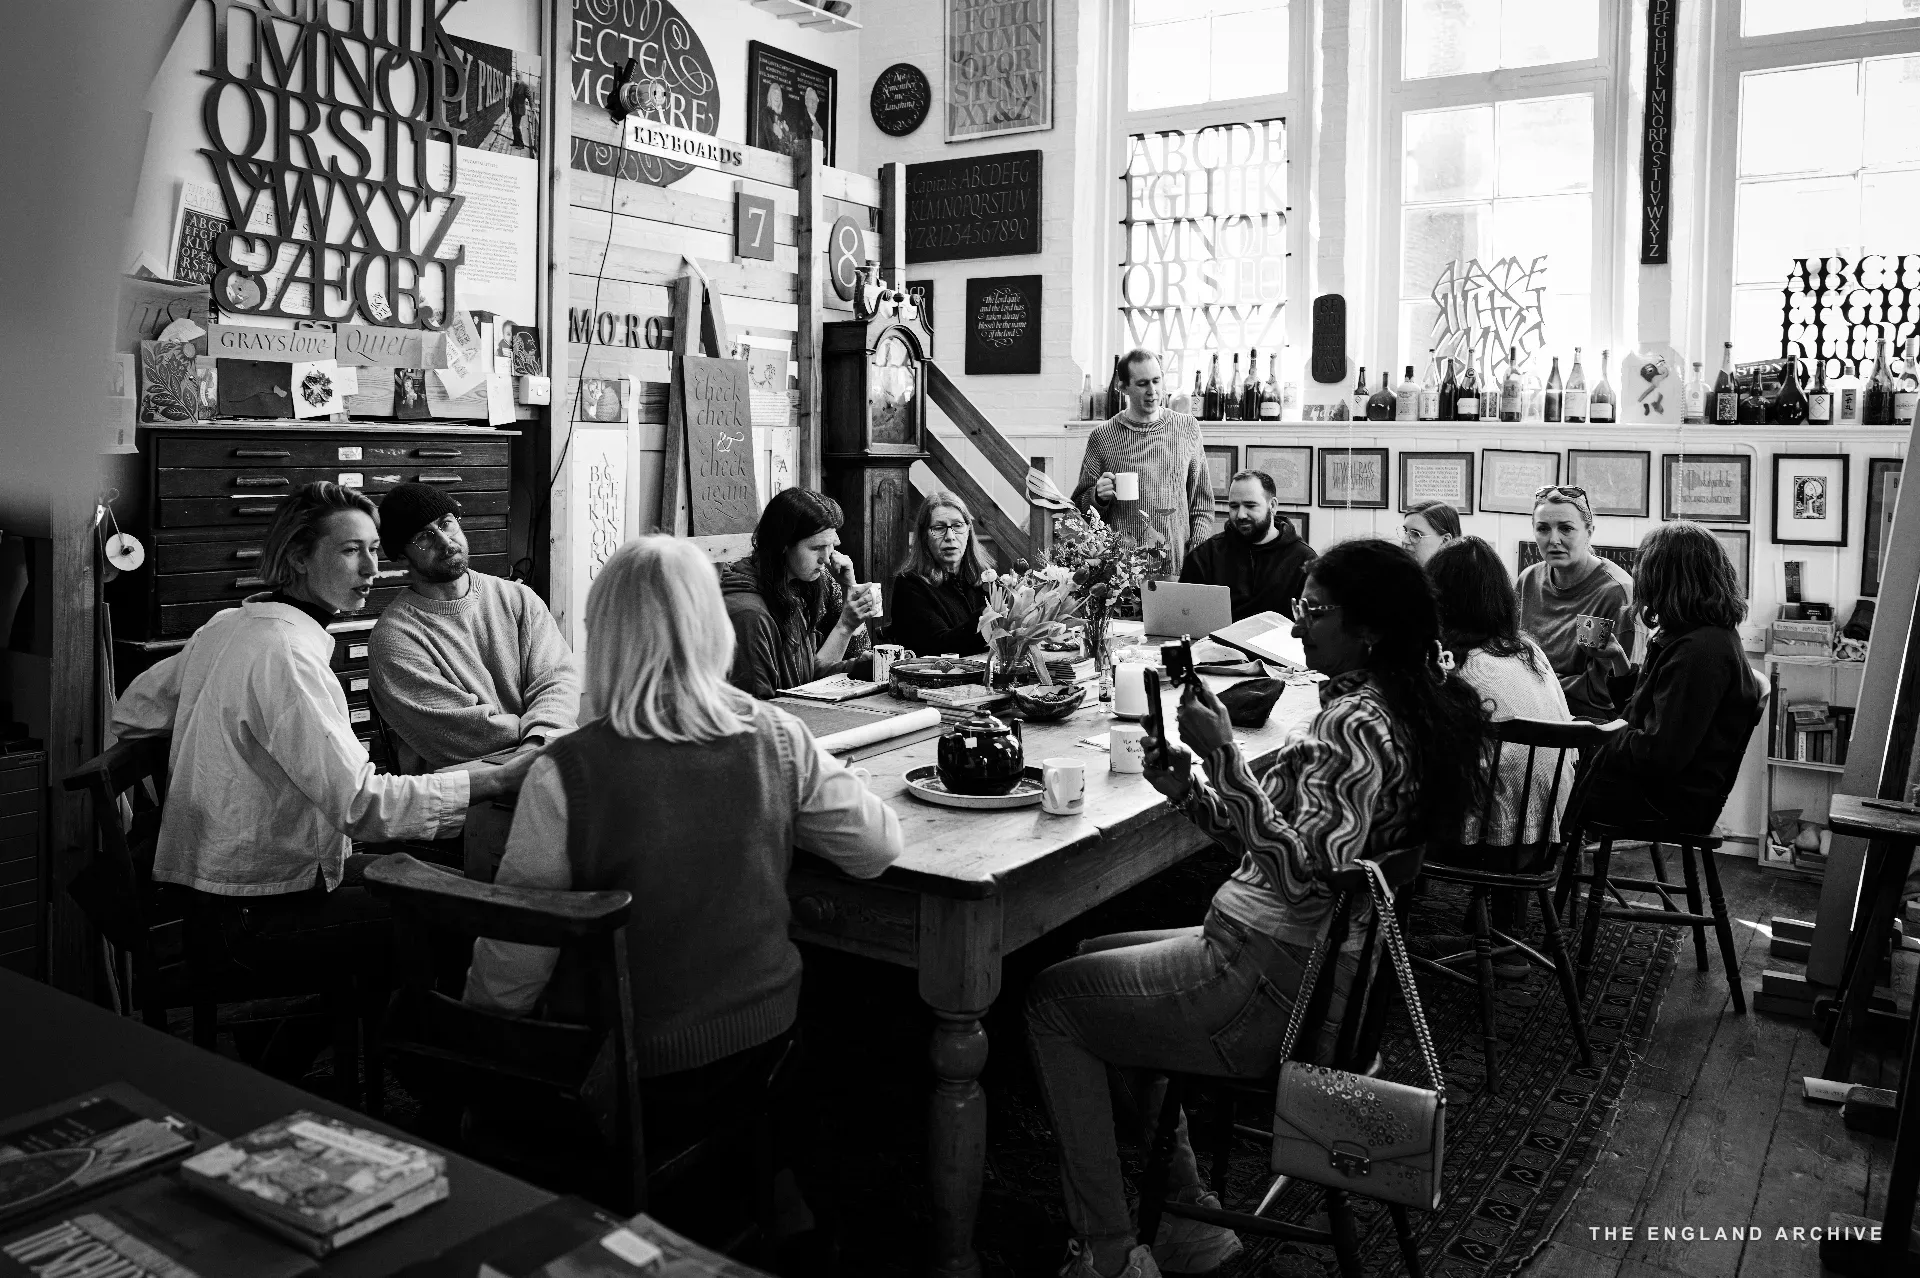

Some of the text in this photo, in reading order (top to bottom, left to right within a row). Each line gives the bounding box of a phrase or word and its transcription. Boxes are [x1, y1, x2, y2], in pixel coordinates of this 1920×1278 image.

[634, 126, 743, 166] KEYBOARDS
[1127, 117, 1288, 176] ABCDE
[913, 170, 957, 198] Capitals
[959, 160, 1031, 190] ABCDEFG
[748, 207, 767, 248] 7
[837, 226, 858, 288] 8
[569, 307, 664, 349] MORO
[717, 431, 744, 453] &
